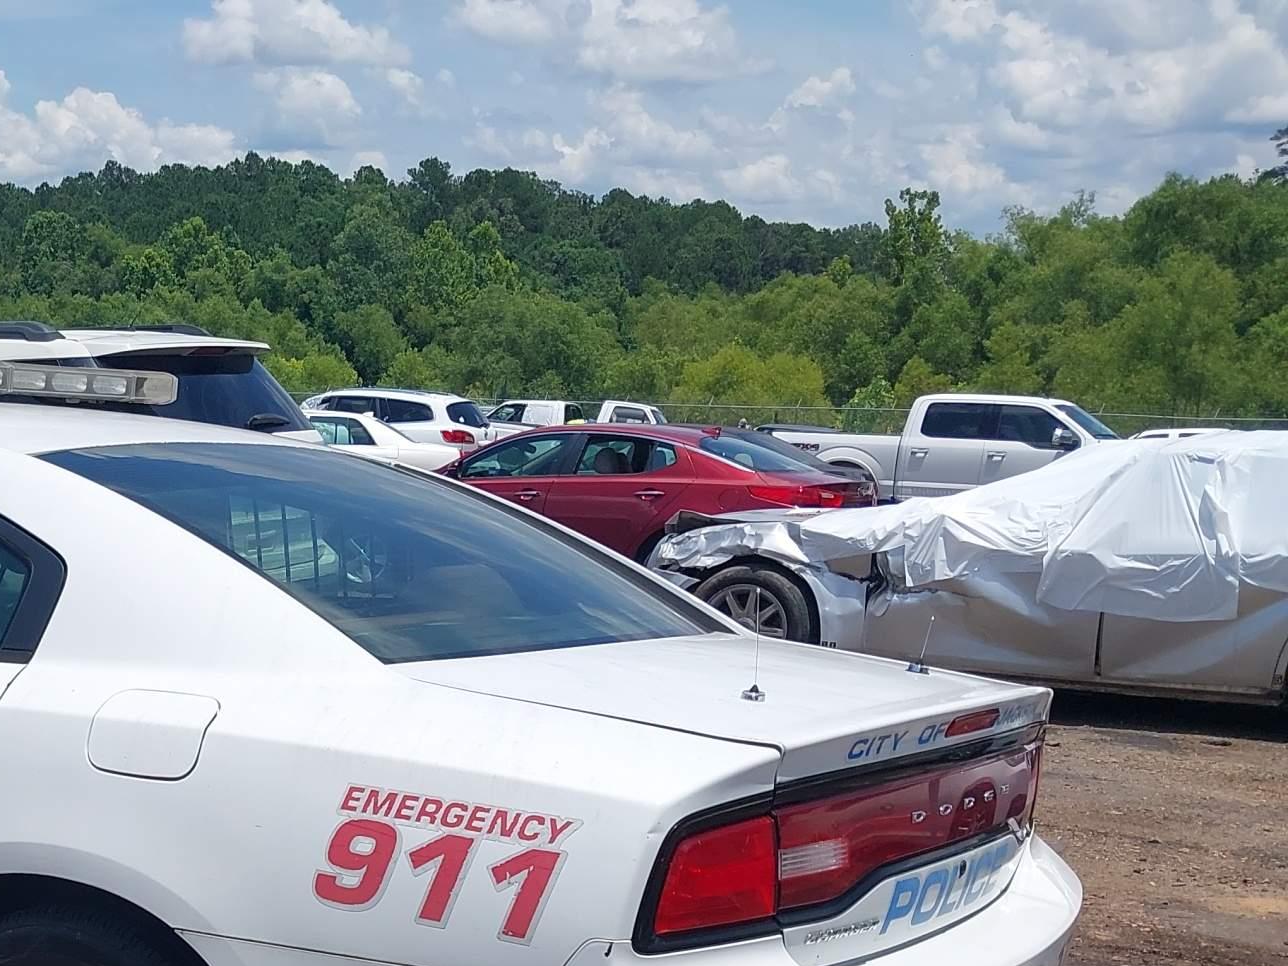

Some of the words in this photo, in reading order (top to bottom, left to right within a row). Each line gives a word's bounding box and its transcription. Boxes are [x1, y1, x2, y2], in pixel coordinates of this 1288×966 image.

[846, 730, 909, 760] CITY
[917, 723, 949, 745] OF
[338, 784, 576, 845] EMERGENCY
[911, 784, 1010, 824] DODGE
[313, 816, 566, 942] 911
[879, 842, 1011, 936] POLICE
